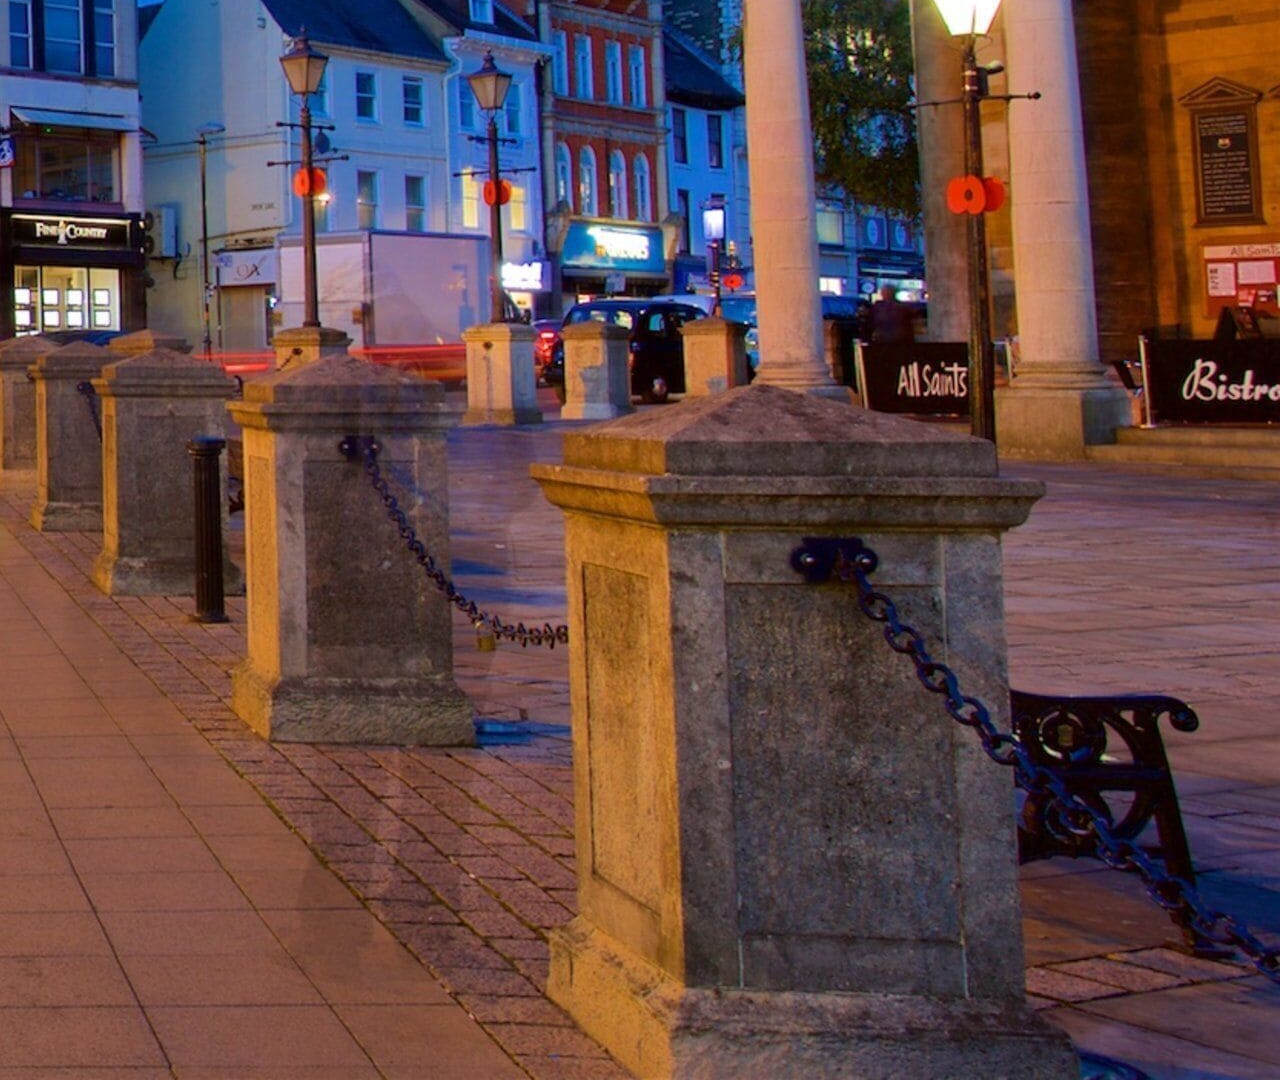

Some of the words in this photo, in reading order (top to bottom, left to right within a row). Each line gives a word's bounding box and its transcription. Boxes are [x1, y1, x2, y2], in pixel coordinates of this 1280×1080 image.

[65, 224, 108, 240] COUNTRY
[897, 361, 920, 398] All
[922, 361, 968, 398] Saints
[1181, 358, 1280, 402] Bistro
